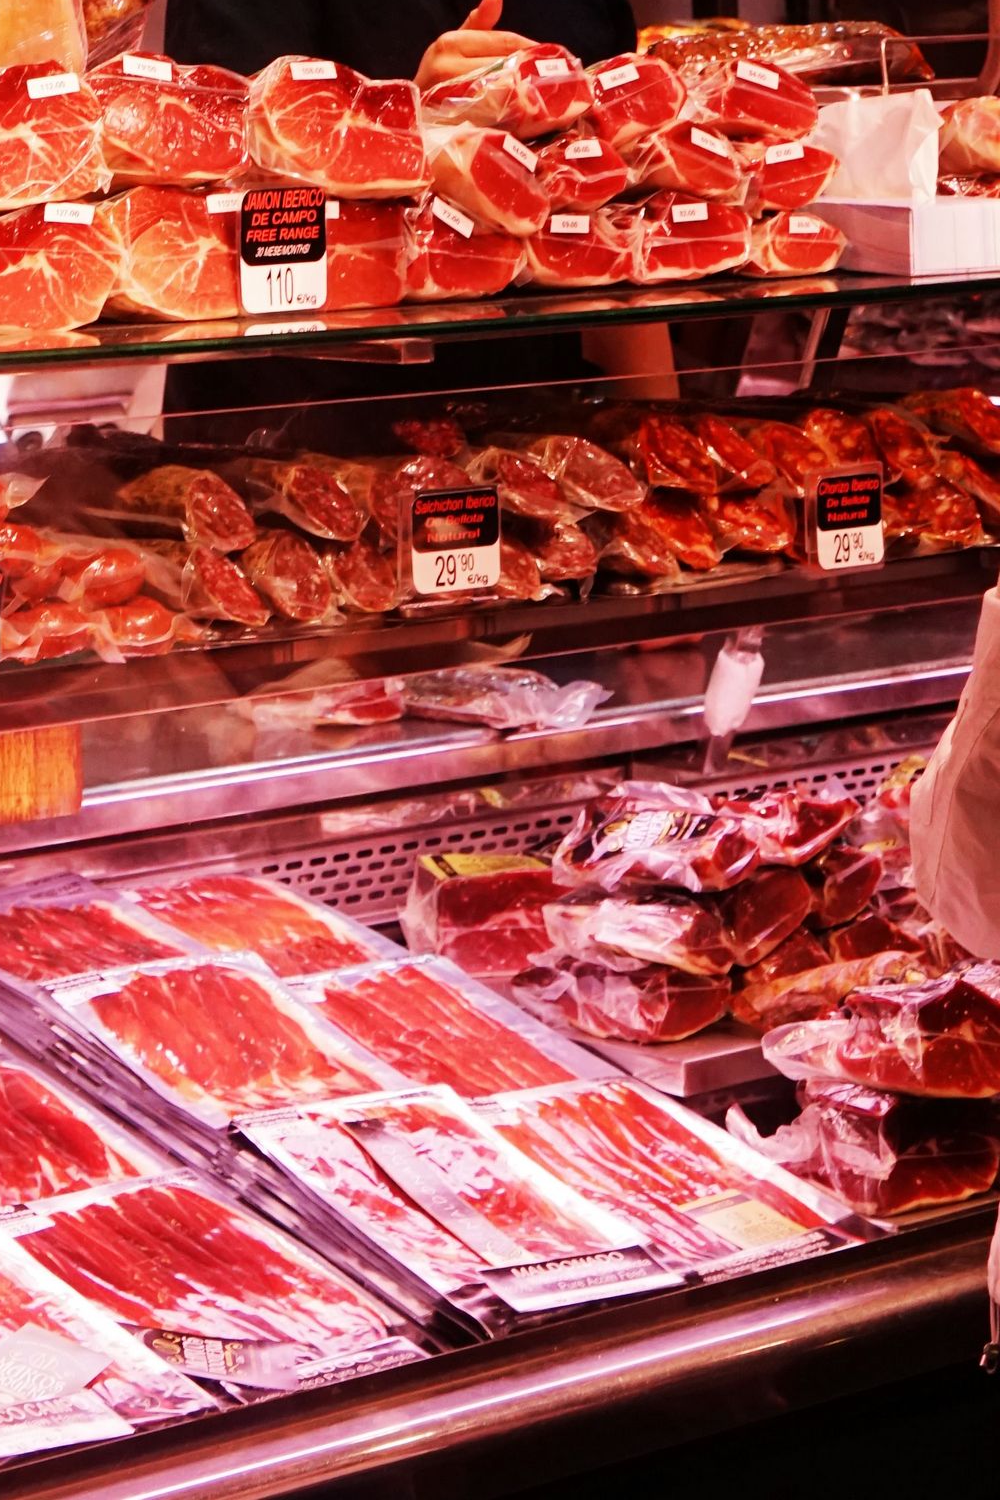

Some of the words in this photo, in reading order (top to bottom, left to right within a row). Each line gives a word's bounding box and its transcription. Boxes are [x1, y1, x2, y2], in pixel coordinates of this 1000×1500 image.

[244, 190, 281, 212] JAMON
[282, 188, 325, 209] IBERICO
[251, 212, 270, 227] DE
[272, 209, 317, 225] CAMPO
[246, 228, 277, 243] FREE
[279, 226, 320, 241] RANGE
[266, 267, 294, 307] 110
[819, 481, 850, 496] Chorizo
[851, 478, 880, 492] Iberico
[415, 498, 464, 515] Salchichon
[465, 495, 496, 510] Iberico
[826, 498, 840, 509] De
[841, 495, 871, 507] Bellota
[446, 513, 485, 526] Bellota
[827, 509, 868, 522] Natural
[427, 527, 481, 543] Natural
